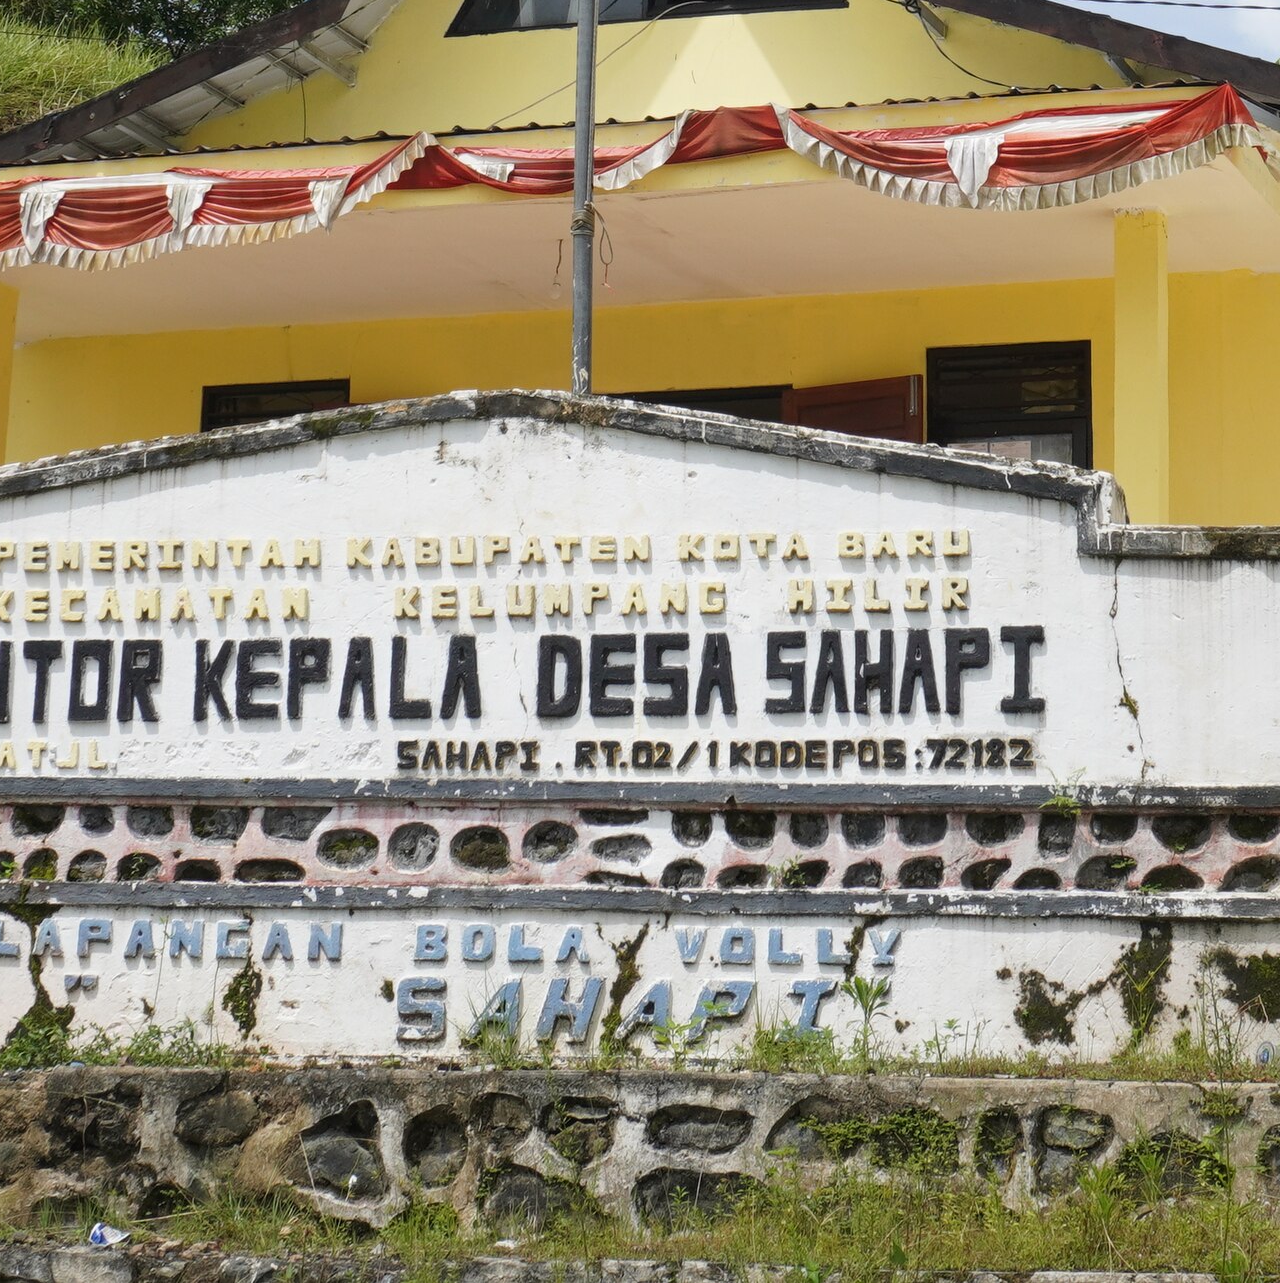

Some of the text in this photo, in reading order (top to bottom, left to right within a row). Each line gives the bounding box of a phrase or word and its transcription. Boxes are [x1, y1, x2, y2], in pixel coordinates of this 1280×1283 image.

[346, 534, 650, 568] KABUPATEN
[678, 532, 809, 562] KOTA
[838, 529, 971, 559] BARU
[393, 580, 727, 618] KELUMPANG
[788, 575, 970, 614] HILIR
[194, 634, 482, 721] KEPALA
[536, 632, 737, 717] DESA
[765, 625, 1046, 715] SAHAPI
[413, 924, 590, 963] BOLA
[674, 926, 902, 966] VOLLY
[395, 975, 840, 1044] SAHAPI
